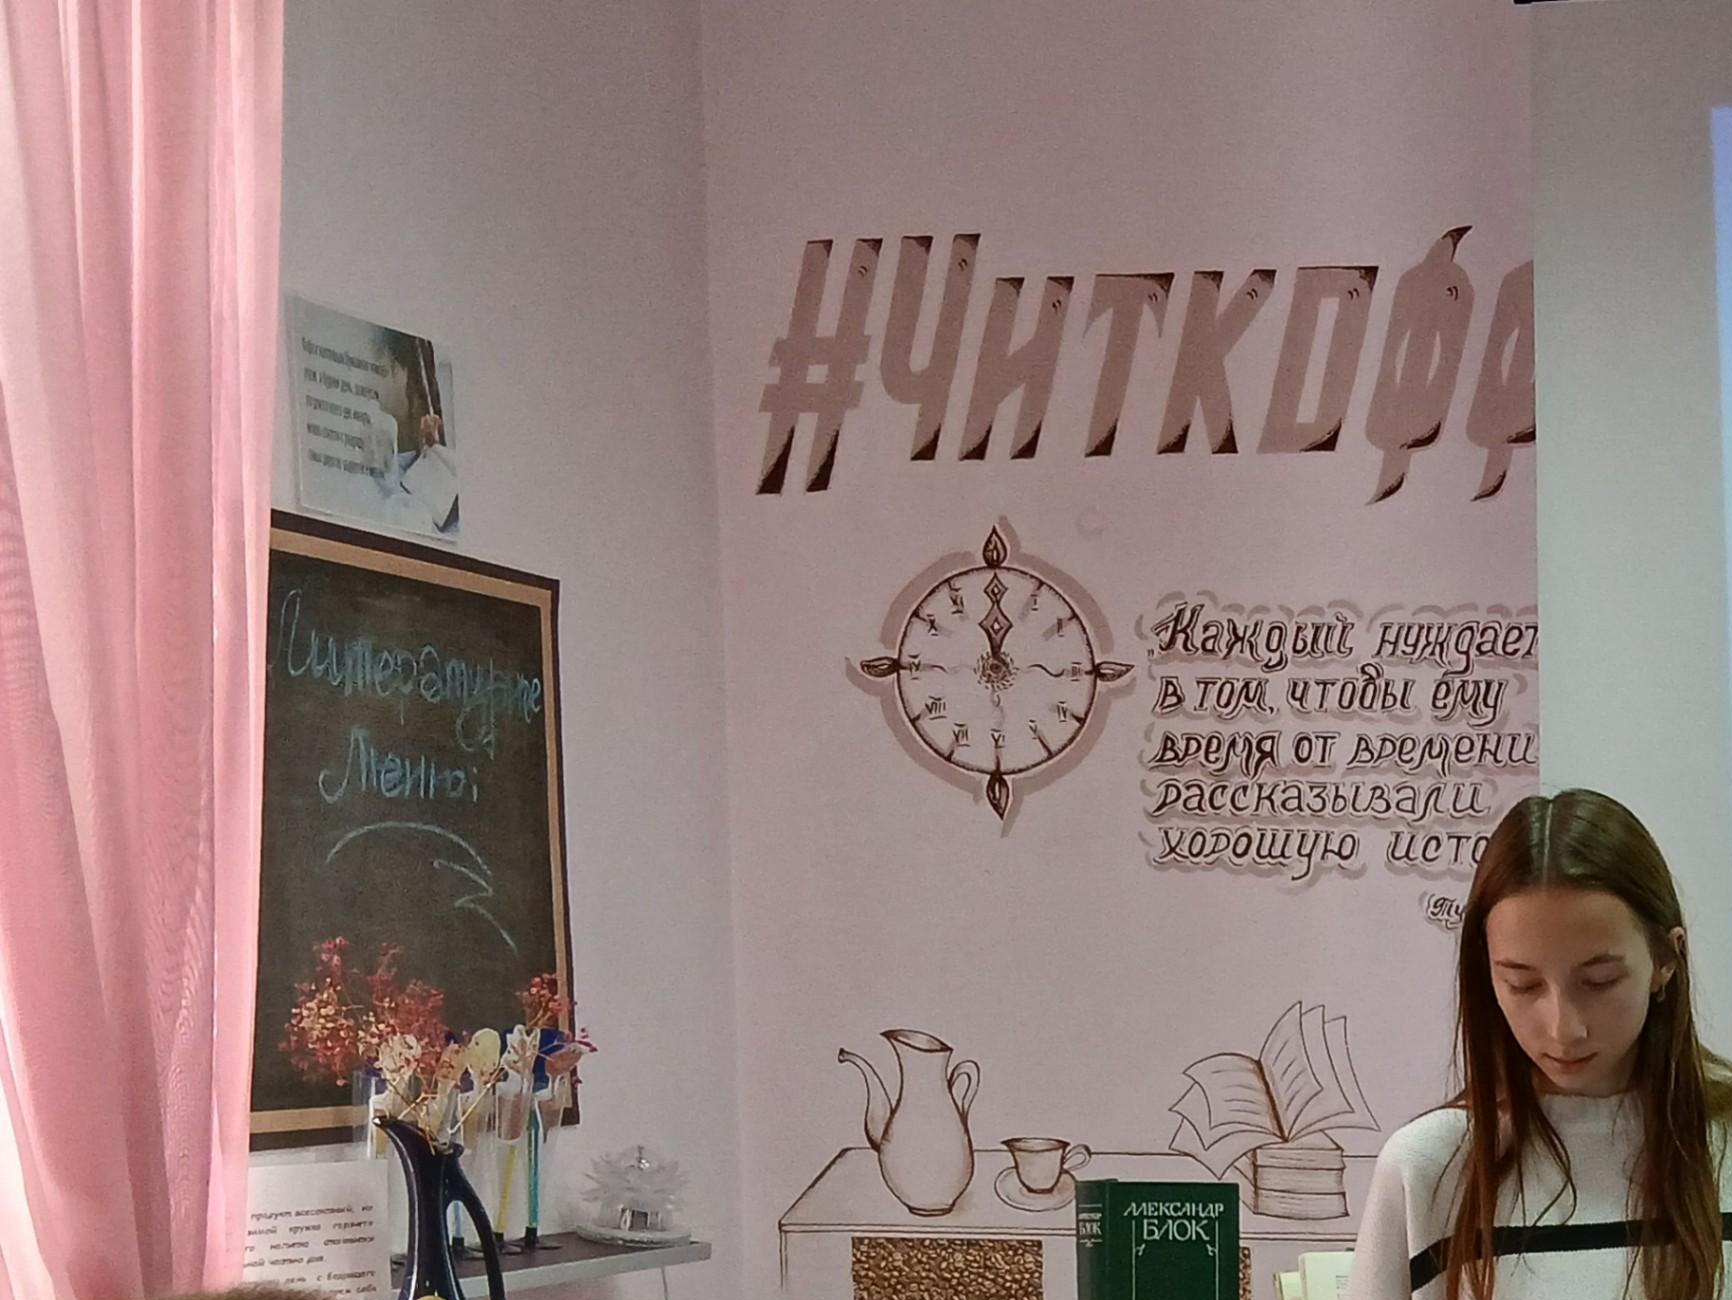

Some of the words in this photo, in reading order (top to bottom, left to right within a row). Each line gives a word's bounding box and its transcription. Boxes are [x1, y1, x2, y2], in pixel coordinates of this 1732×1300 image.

[1196, 677, 1275, 720] том,
[1286, 662, 1415, 714] чтобы
[1430, 677, 1508, 728] ему
[1148, 730, 1283, 780] время
[1292, 732, 1341, 768] от
[1346, 732, 1538, 778] времени
[1151, 778, 1490, 824] рассказывали
[1153, 826, 1361, 880] хорошую
[1123, 1201, 1225, 1218] АЛЕКСАНДР
[1142, 1218, 1211, 1241] БЛОК
